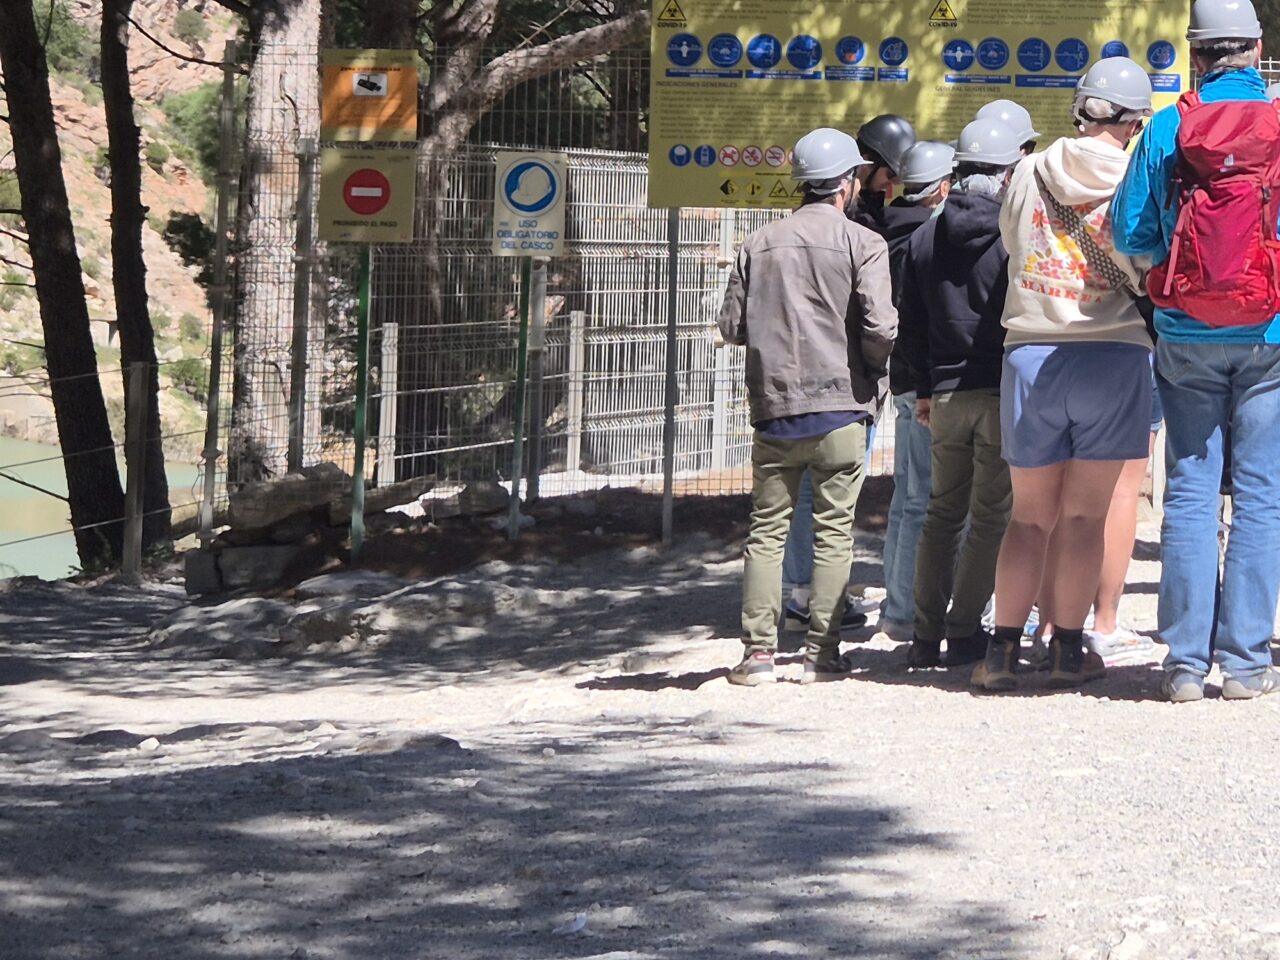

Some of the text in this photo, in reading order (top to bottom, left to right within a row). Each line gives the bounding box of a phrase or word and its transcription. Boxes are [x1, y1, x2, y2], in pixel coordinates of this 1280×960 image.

[380, 220, 398, 228] PASO
[518, 219, 538, 228] USO
[496, 229, 560, 240] OBLIGATORIO
[500, 240, 554, 250] DEL CASCO
